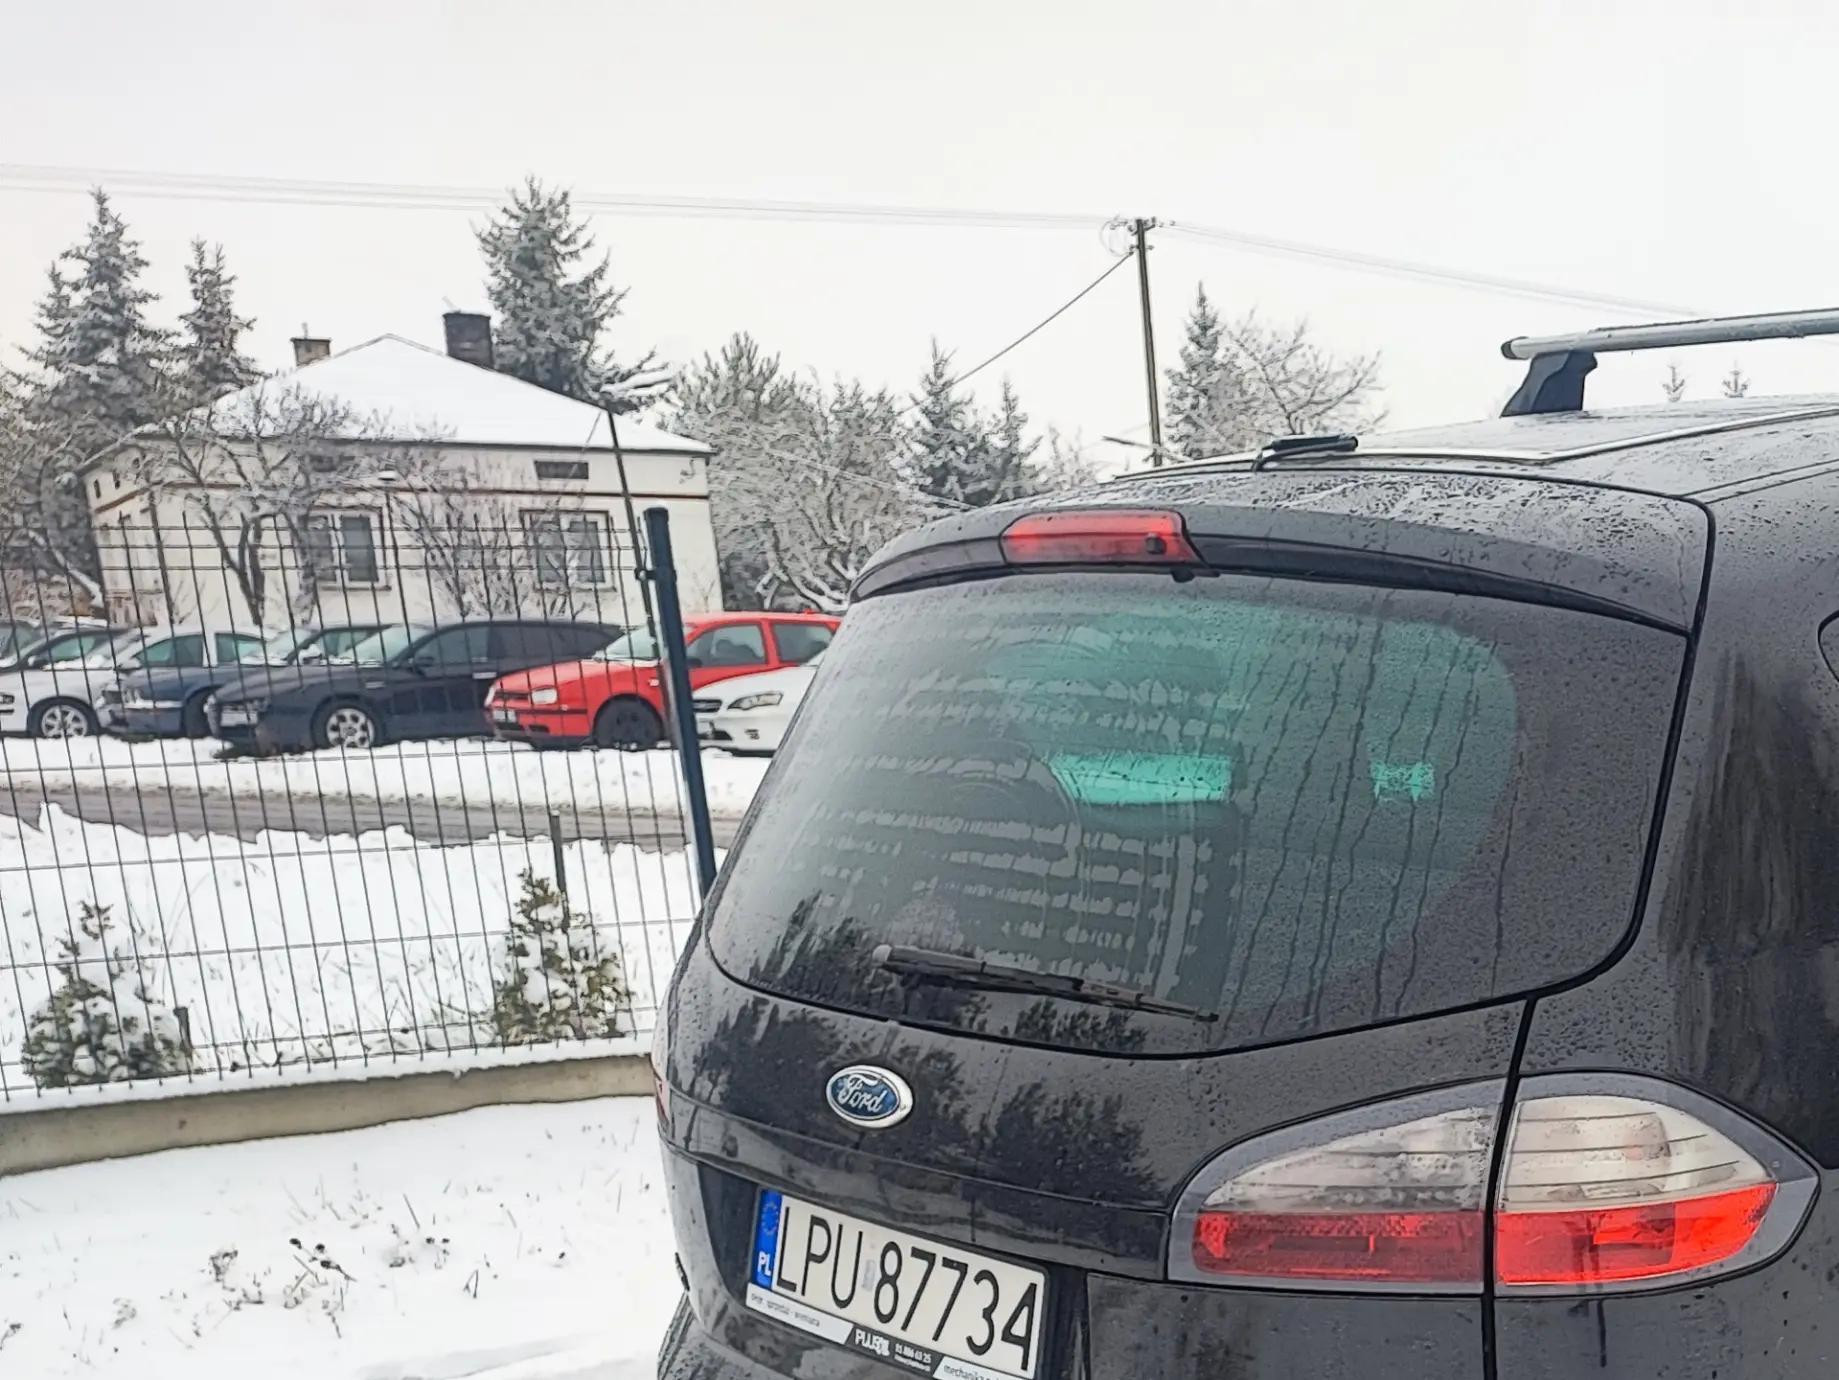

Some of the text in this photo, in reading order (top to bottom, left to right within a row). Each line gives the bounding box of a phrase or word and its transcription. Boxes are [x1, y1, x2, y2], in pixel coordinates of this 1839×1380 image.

[837, 1074, 888, 1113] Ford
[757, 1251, 772, 1277] PL
[776, 1206, 1038, 1372] LPU 87734
